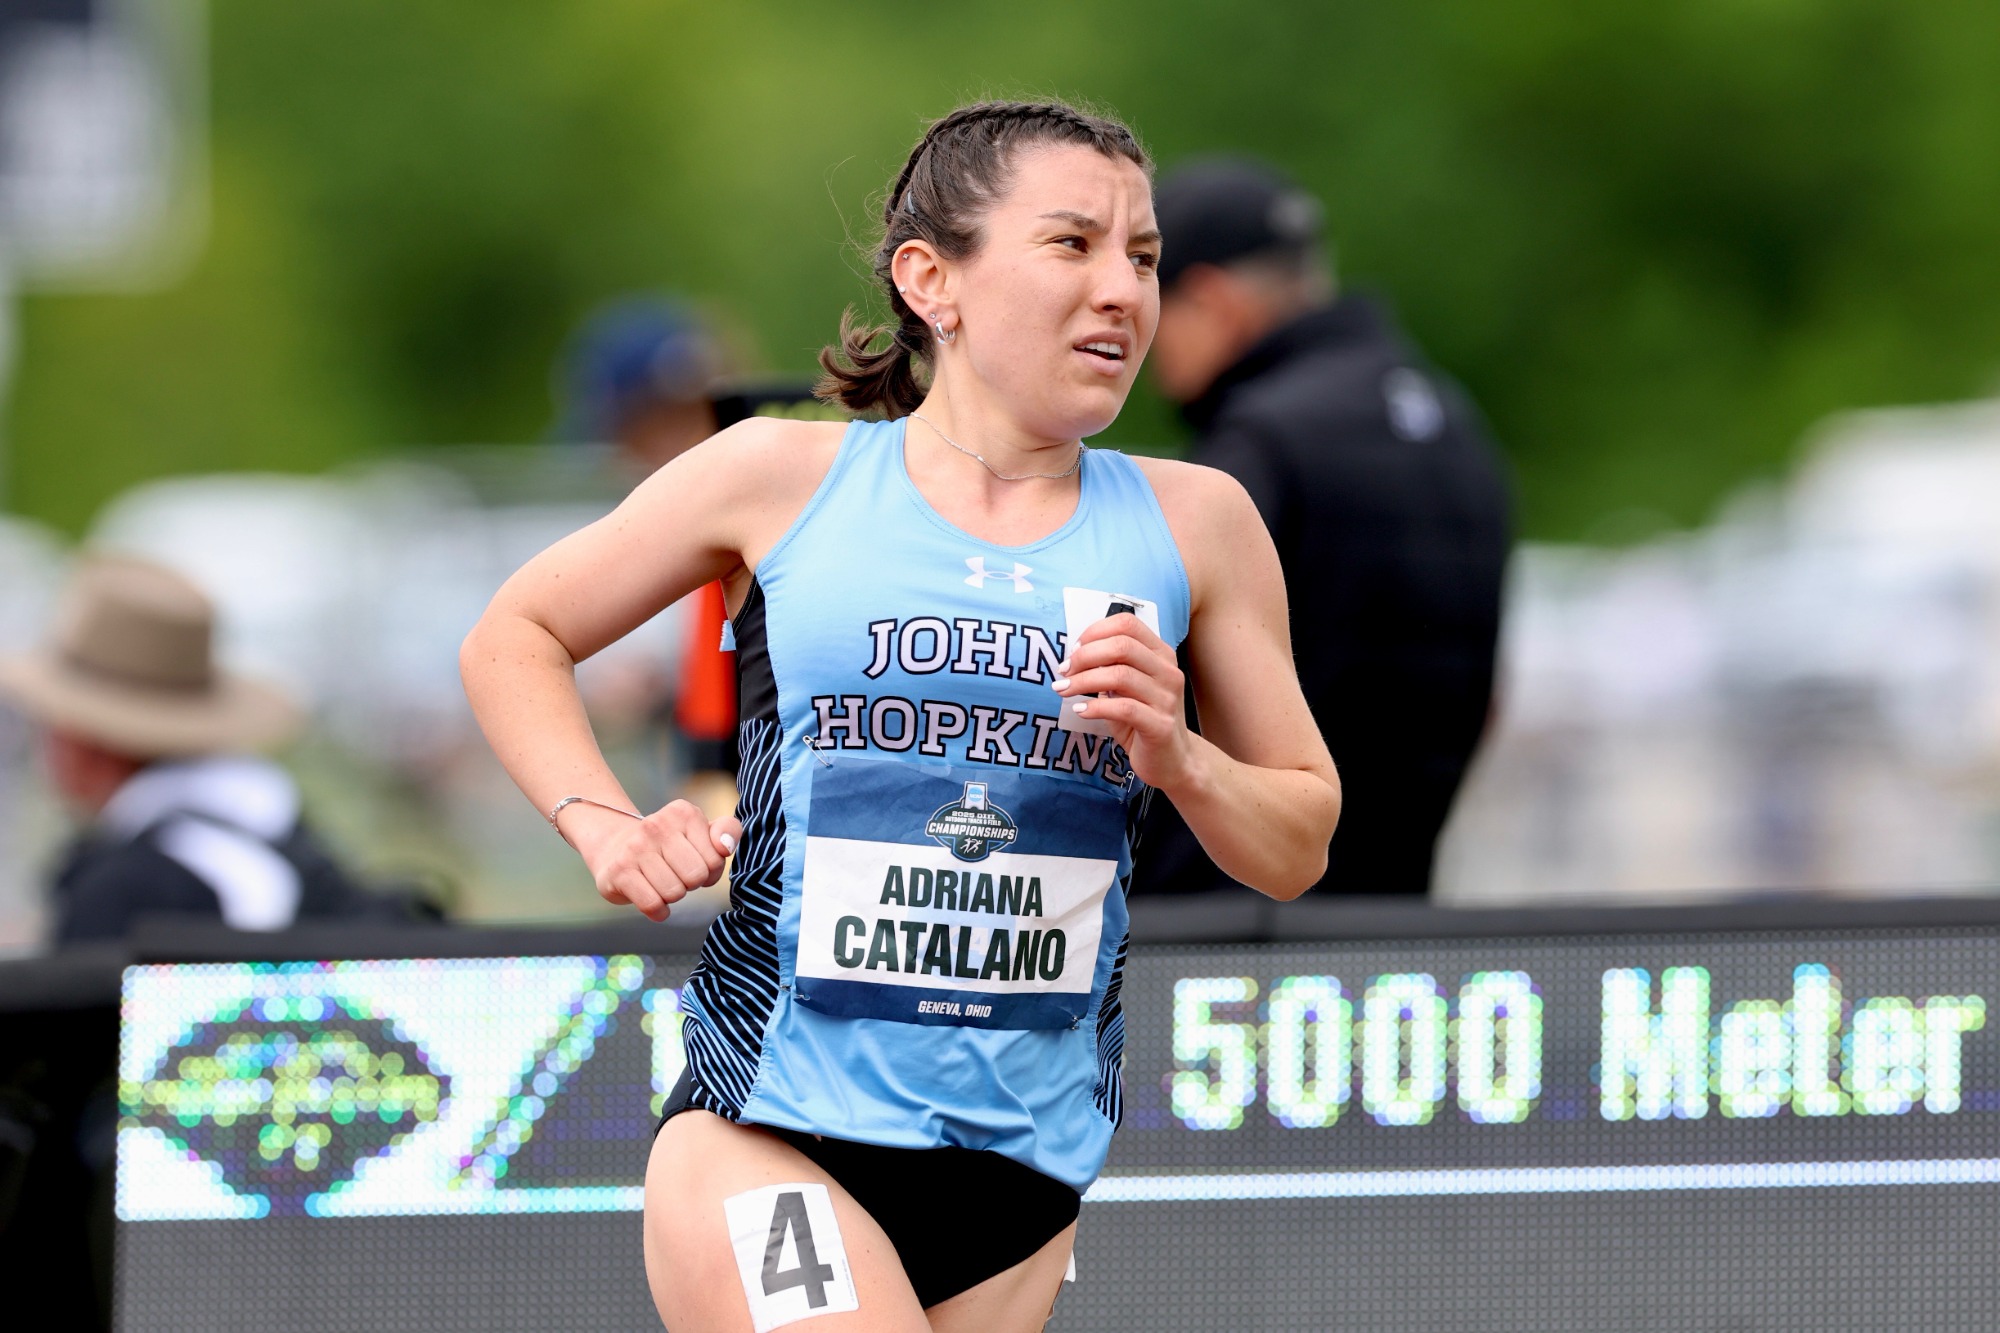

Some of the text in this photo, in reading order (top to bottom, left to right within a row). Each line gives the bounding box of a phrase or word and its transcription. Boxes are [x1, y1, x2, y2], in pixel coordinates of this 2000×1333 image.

[862, 616, 1068, 685] JOHN
[811, 694, 1129, 787] HOPKINS
[928, 822, 1016, 840] CHAMPIONSHIPS
[951, 810, 975, 819] 2025
[968, 817, 982, 825] TRACK
[879, 865, 1043, 917] ADRIANA
[833, 915, 1066, 981] CATALANO
[917, 1000, 992, 1018] GENEVA, OHIO
[1172, 970, 1543, 1129] 5000
[761, 1191, 835, 1309] 4
